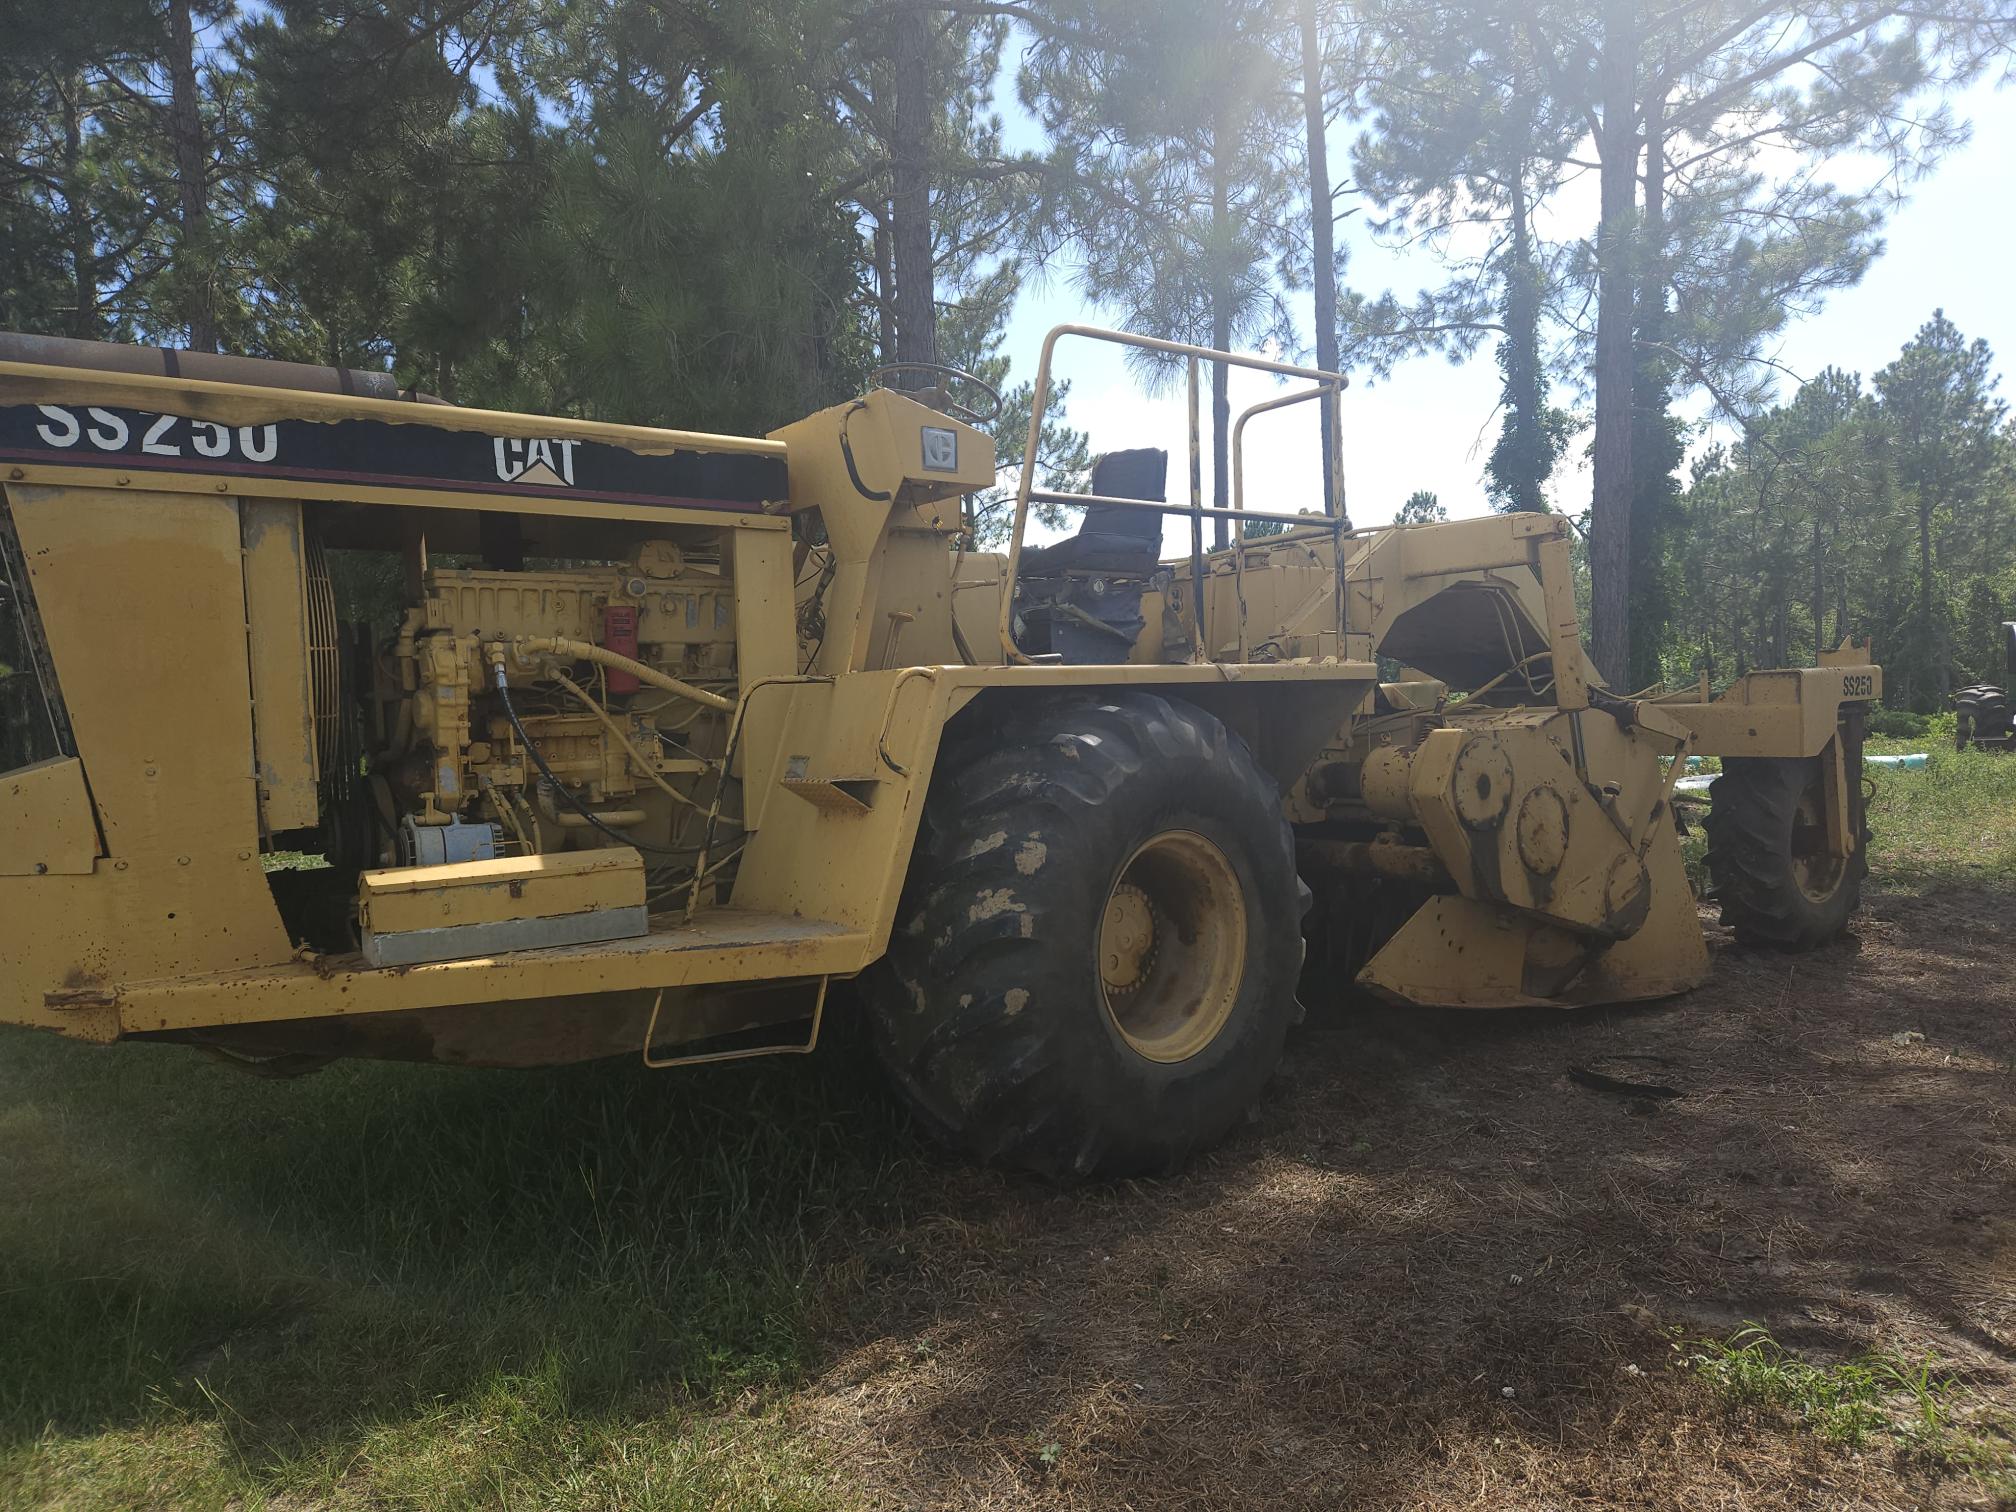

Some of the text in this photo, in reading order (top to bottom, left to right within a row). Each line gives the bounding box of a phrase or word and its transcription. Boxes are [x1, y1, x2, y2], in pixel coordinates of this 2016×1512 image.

[35, 404, 278, 463] SS250
[493, 436, 582, 486] CAT
[1843, 675, 1872, 697] SS250
